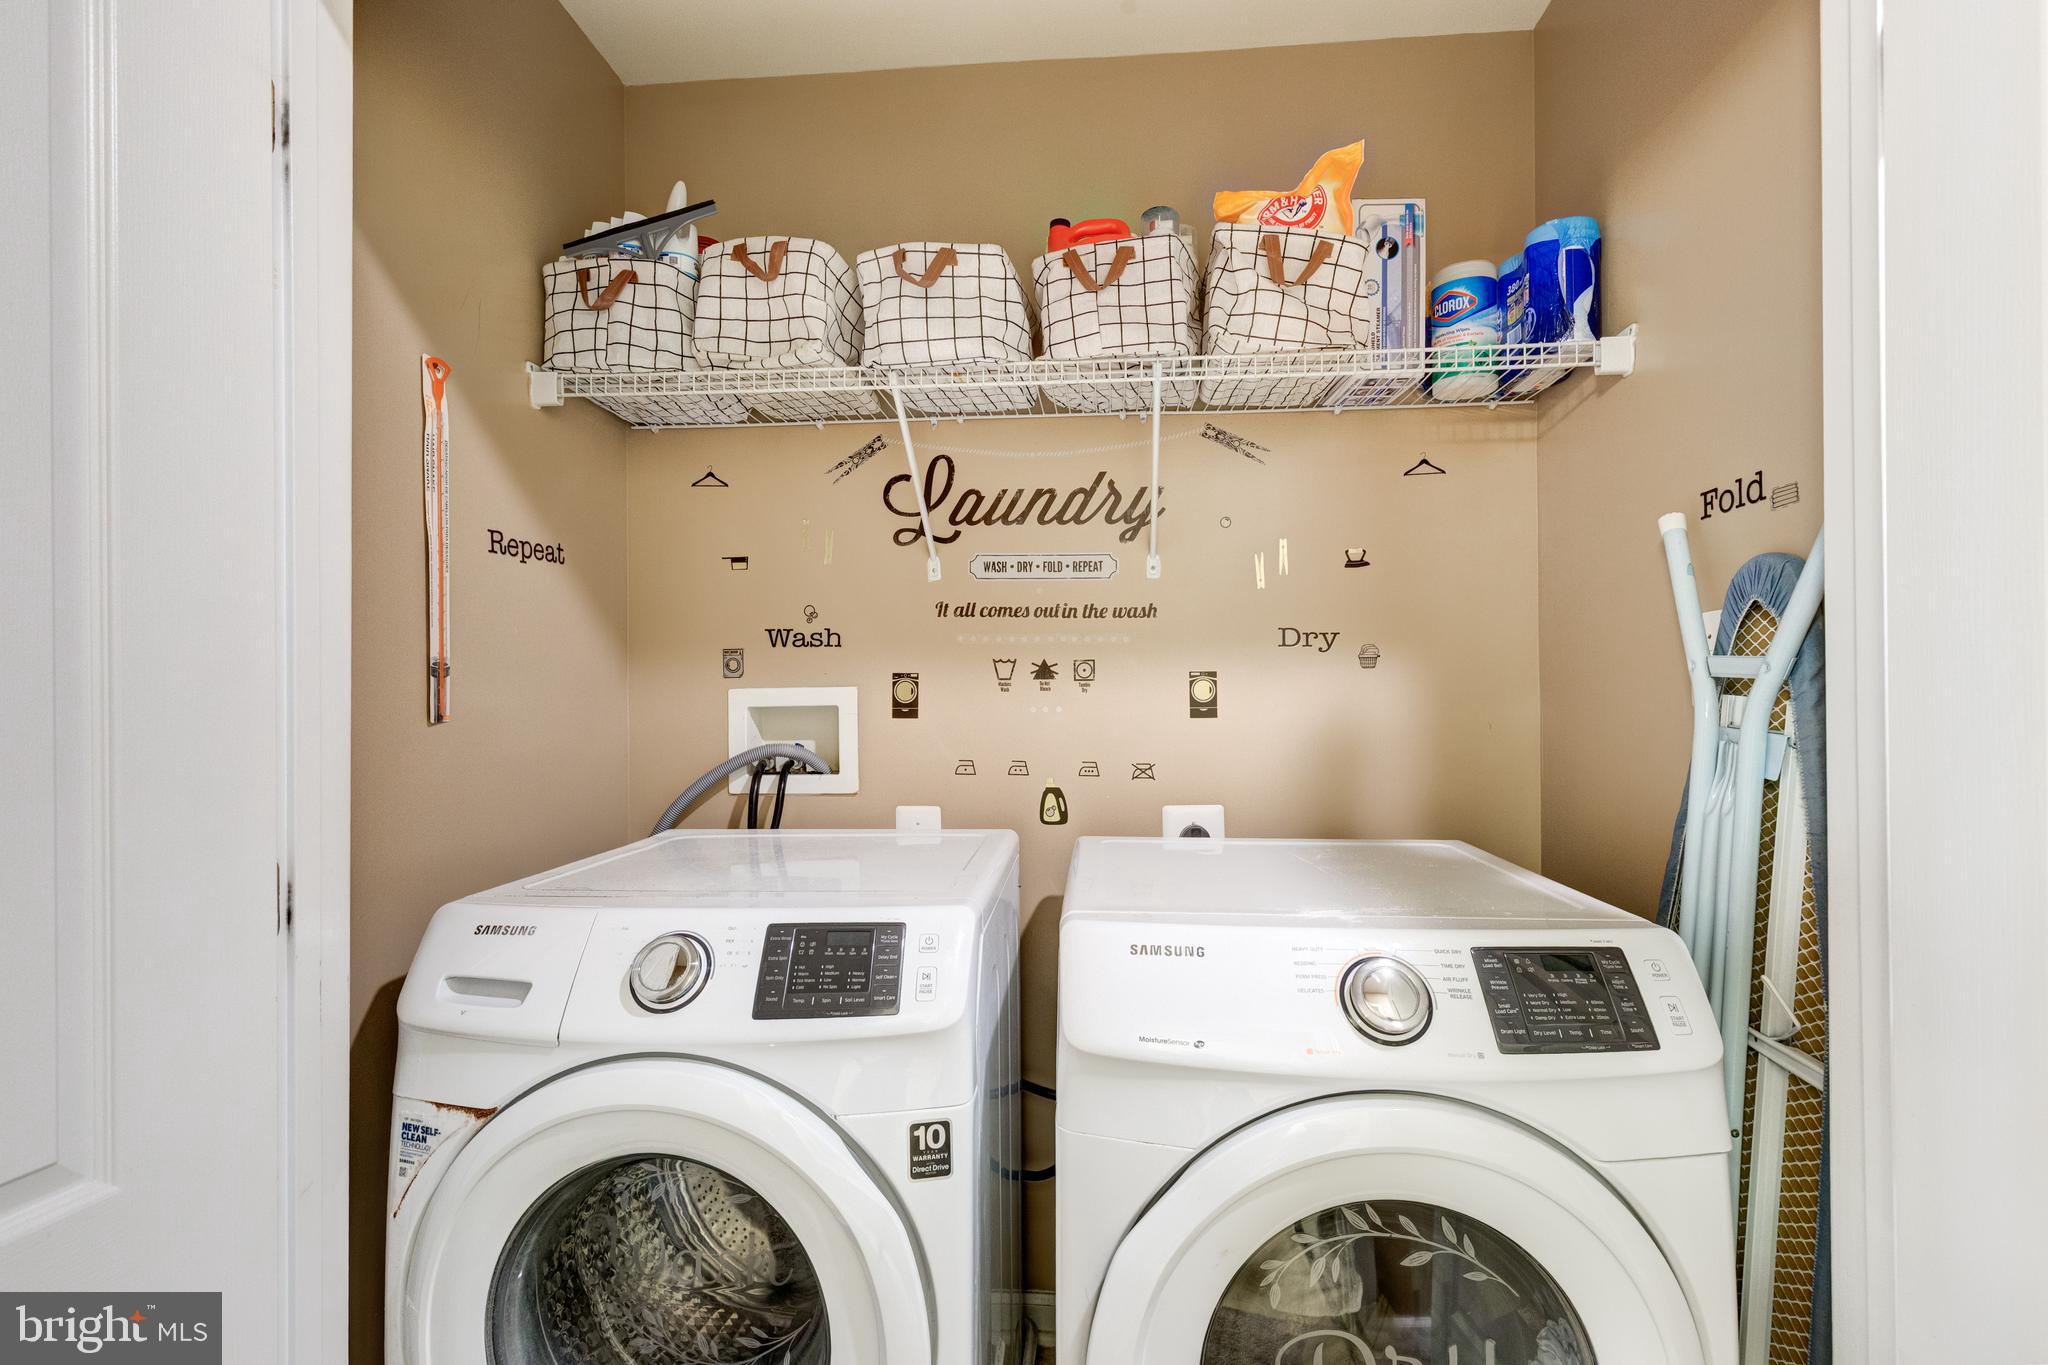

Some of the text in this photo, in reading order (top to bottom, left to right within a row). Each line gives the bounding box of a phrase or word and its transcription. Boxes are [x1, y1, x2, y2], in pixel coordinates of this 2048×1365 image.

[1262, 201, 1280, 218] RM
[1434, 296, 1470, 318] CLOROX
[883, 454, 1165, 546] Laundry
[1700, 470, 1766, 520] Fold
[487, 528, 565, 564] Repeat
[983, 560, 1104, 573] WASH DRY FOLD REPEAT
[935, 601, 1158, 619] It all comes out in the wash
[765, 628, 842, 648] Wash
[1278, 627, 1340, 652] Dry
[474, 925, 538, 936] SAMSUNG
[1130, 944, 1205, 958] SAMSUNG
[1139, 1036, 1190, 1046] MoistureSensor
[402, 1122, 441, 1136] NEW SELF-
[402, 1132, 427, 1144] CLEAN
[914, 1124, 946, 1150] 10
[401, 1141, 431, 1152] TECHNOLOGY
[912, 1153, 948, 1162] WARRANTY
[912, 1165, 932, 1173] Direct
